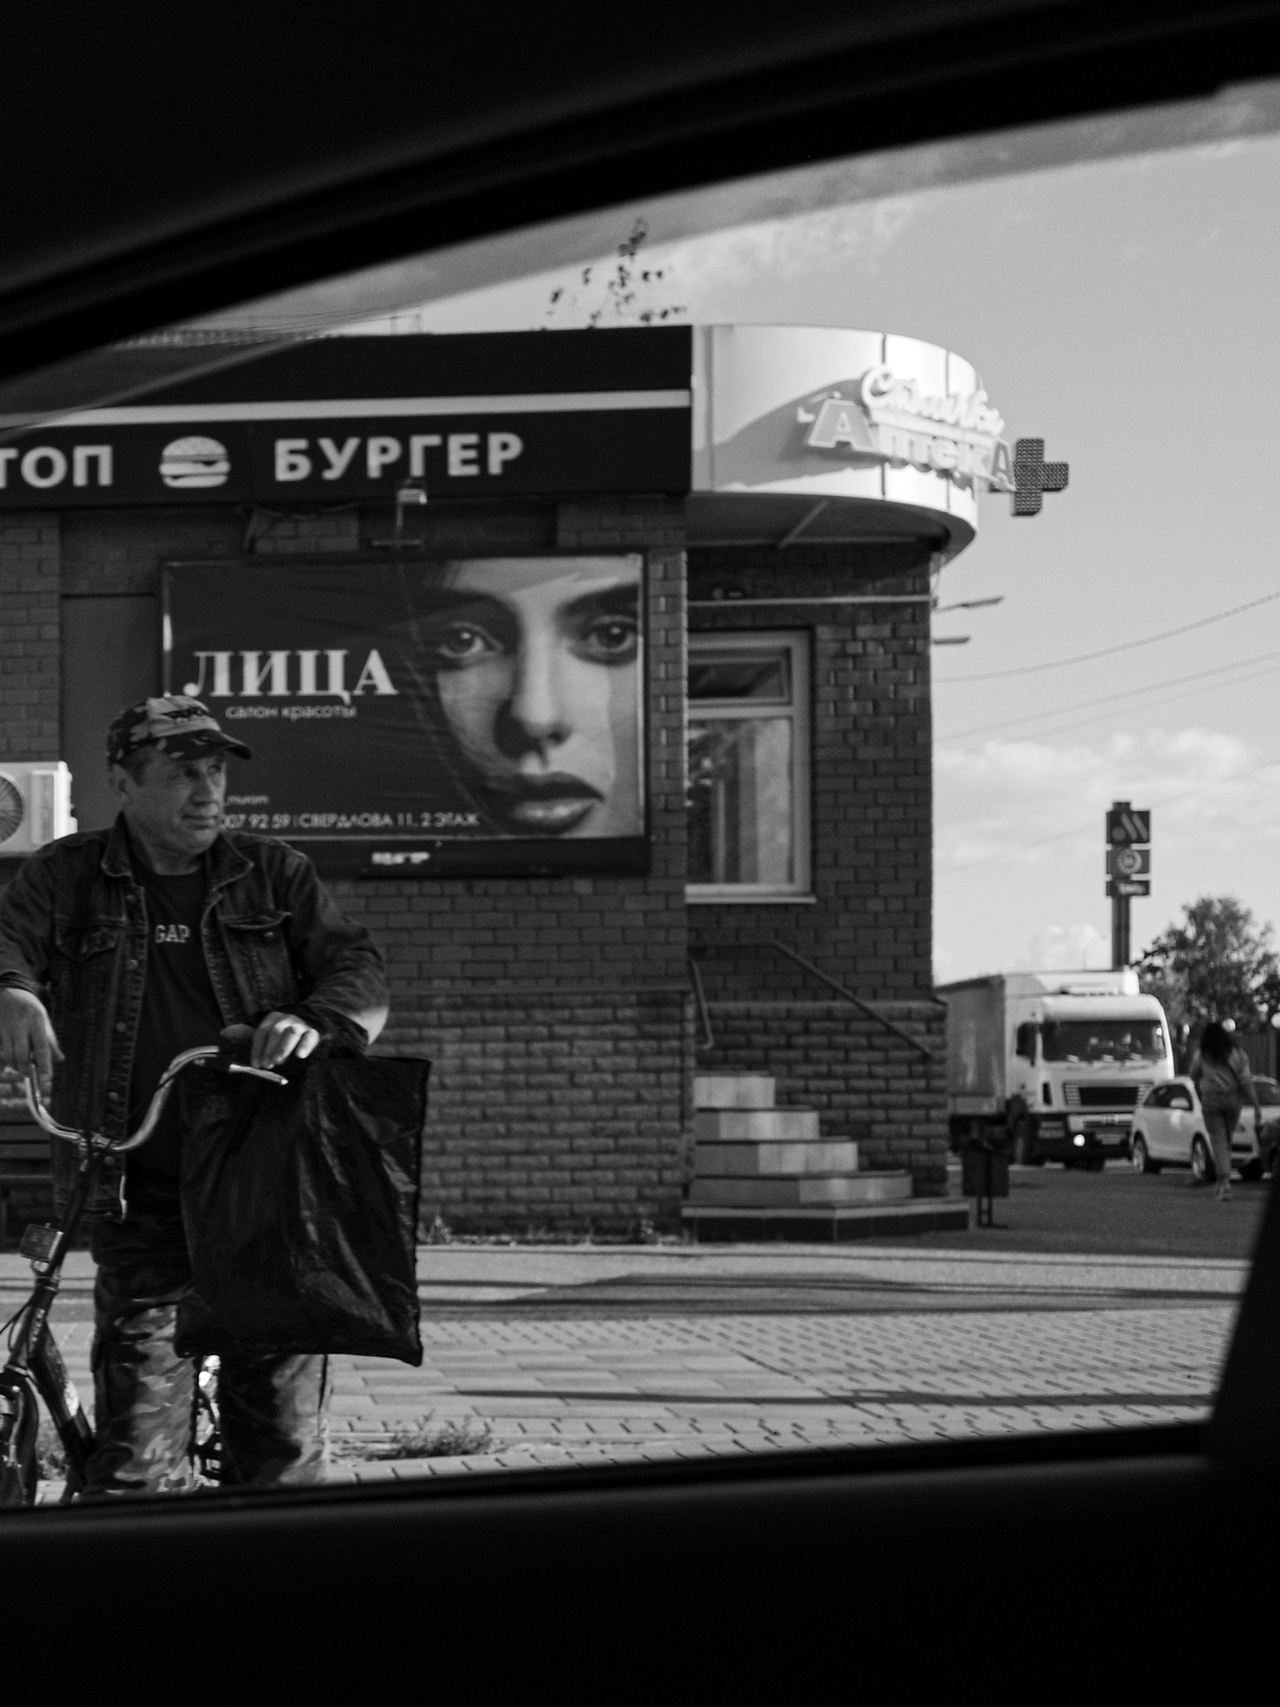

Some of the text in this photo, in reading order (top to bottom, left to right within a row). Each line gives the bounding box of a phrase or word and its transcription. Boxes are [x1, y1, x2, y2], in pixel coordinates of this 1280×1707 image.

[275, 433, 524, 482] БУРГЕР
[183, 649, 399, 706] ЛИЦА
[225, 705, 357, 722] салон красоты
[248, 813, 269, 829] 92
[271, 813, 291, 829] 59
[298, 813, 394, 829] СВЕРДЛОВА
[421, 812, 432, 828] 2
[434, 812, 480, 829] ЭТАЖ
[155, 925, 190, 943] GAP
